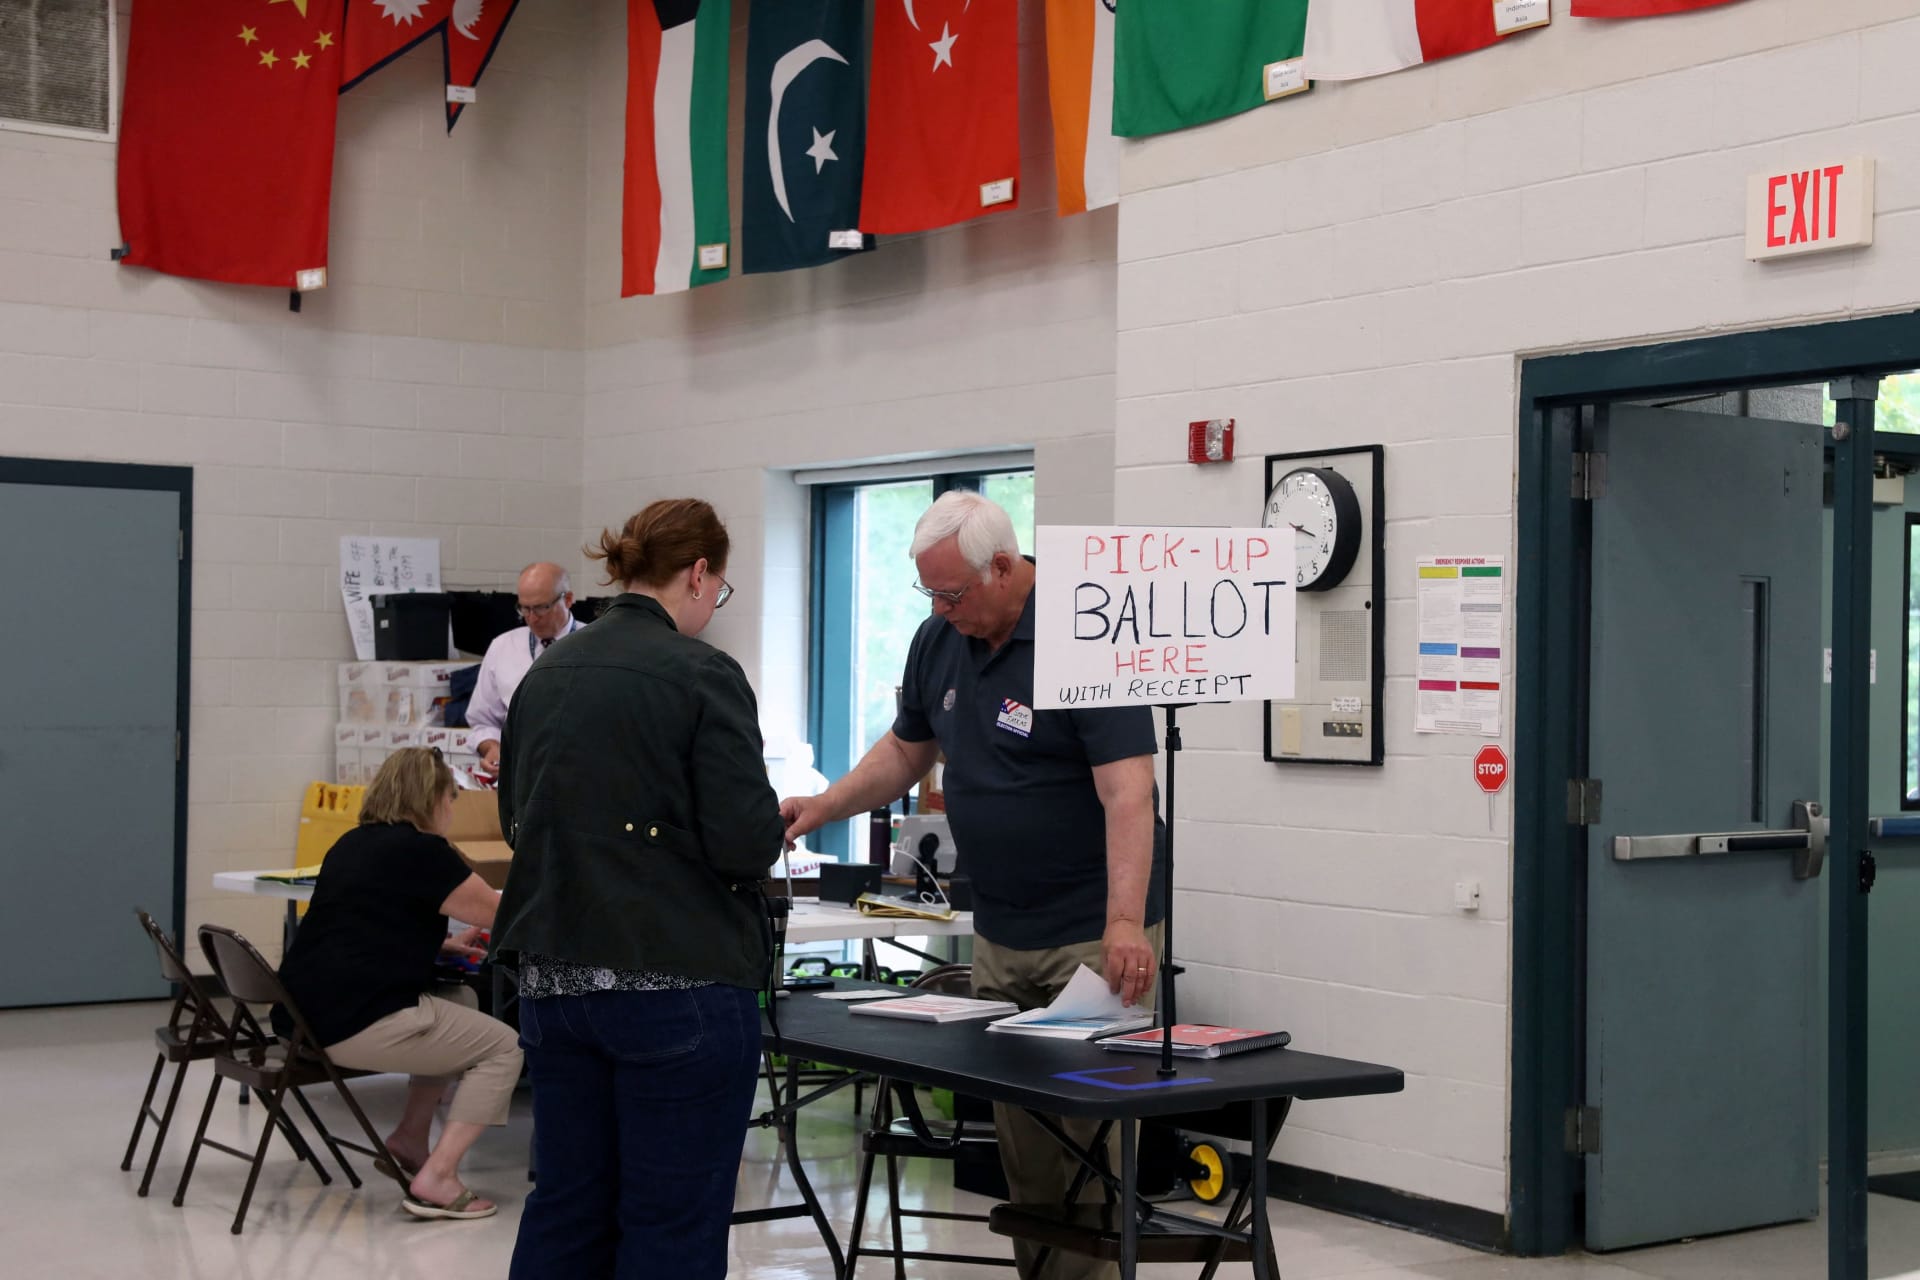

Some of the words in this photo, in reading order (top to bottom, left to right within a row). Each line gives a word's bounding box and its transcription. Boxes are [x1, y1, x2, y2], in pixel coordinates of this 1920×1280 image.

[1767, 165, 1844, 248] EXIT
[1282, 483, 1289, 495] 11
[1324, 494, 1330, 507] 2
[1270, 502, 1279, 514] 10
[1327, 518, 1334, 532] 3
[1084, 533, 1270, 574] PICK-UP
[1322, 543, 1329, 555] 4
[1312, 562, 1318, 576] 5
[1297, 570, 1304, 583] 6
[343, 570, 362, 604] WIPE
[1074, 579, 1287, 644] BALLOT
[1115, 644, 1209, 677] HERE
[1059, 682, 1111, 704] WITH
[1127, 674, 1252, 698] RECEIPT
[1478, 763, 1504, 775] STOP
